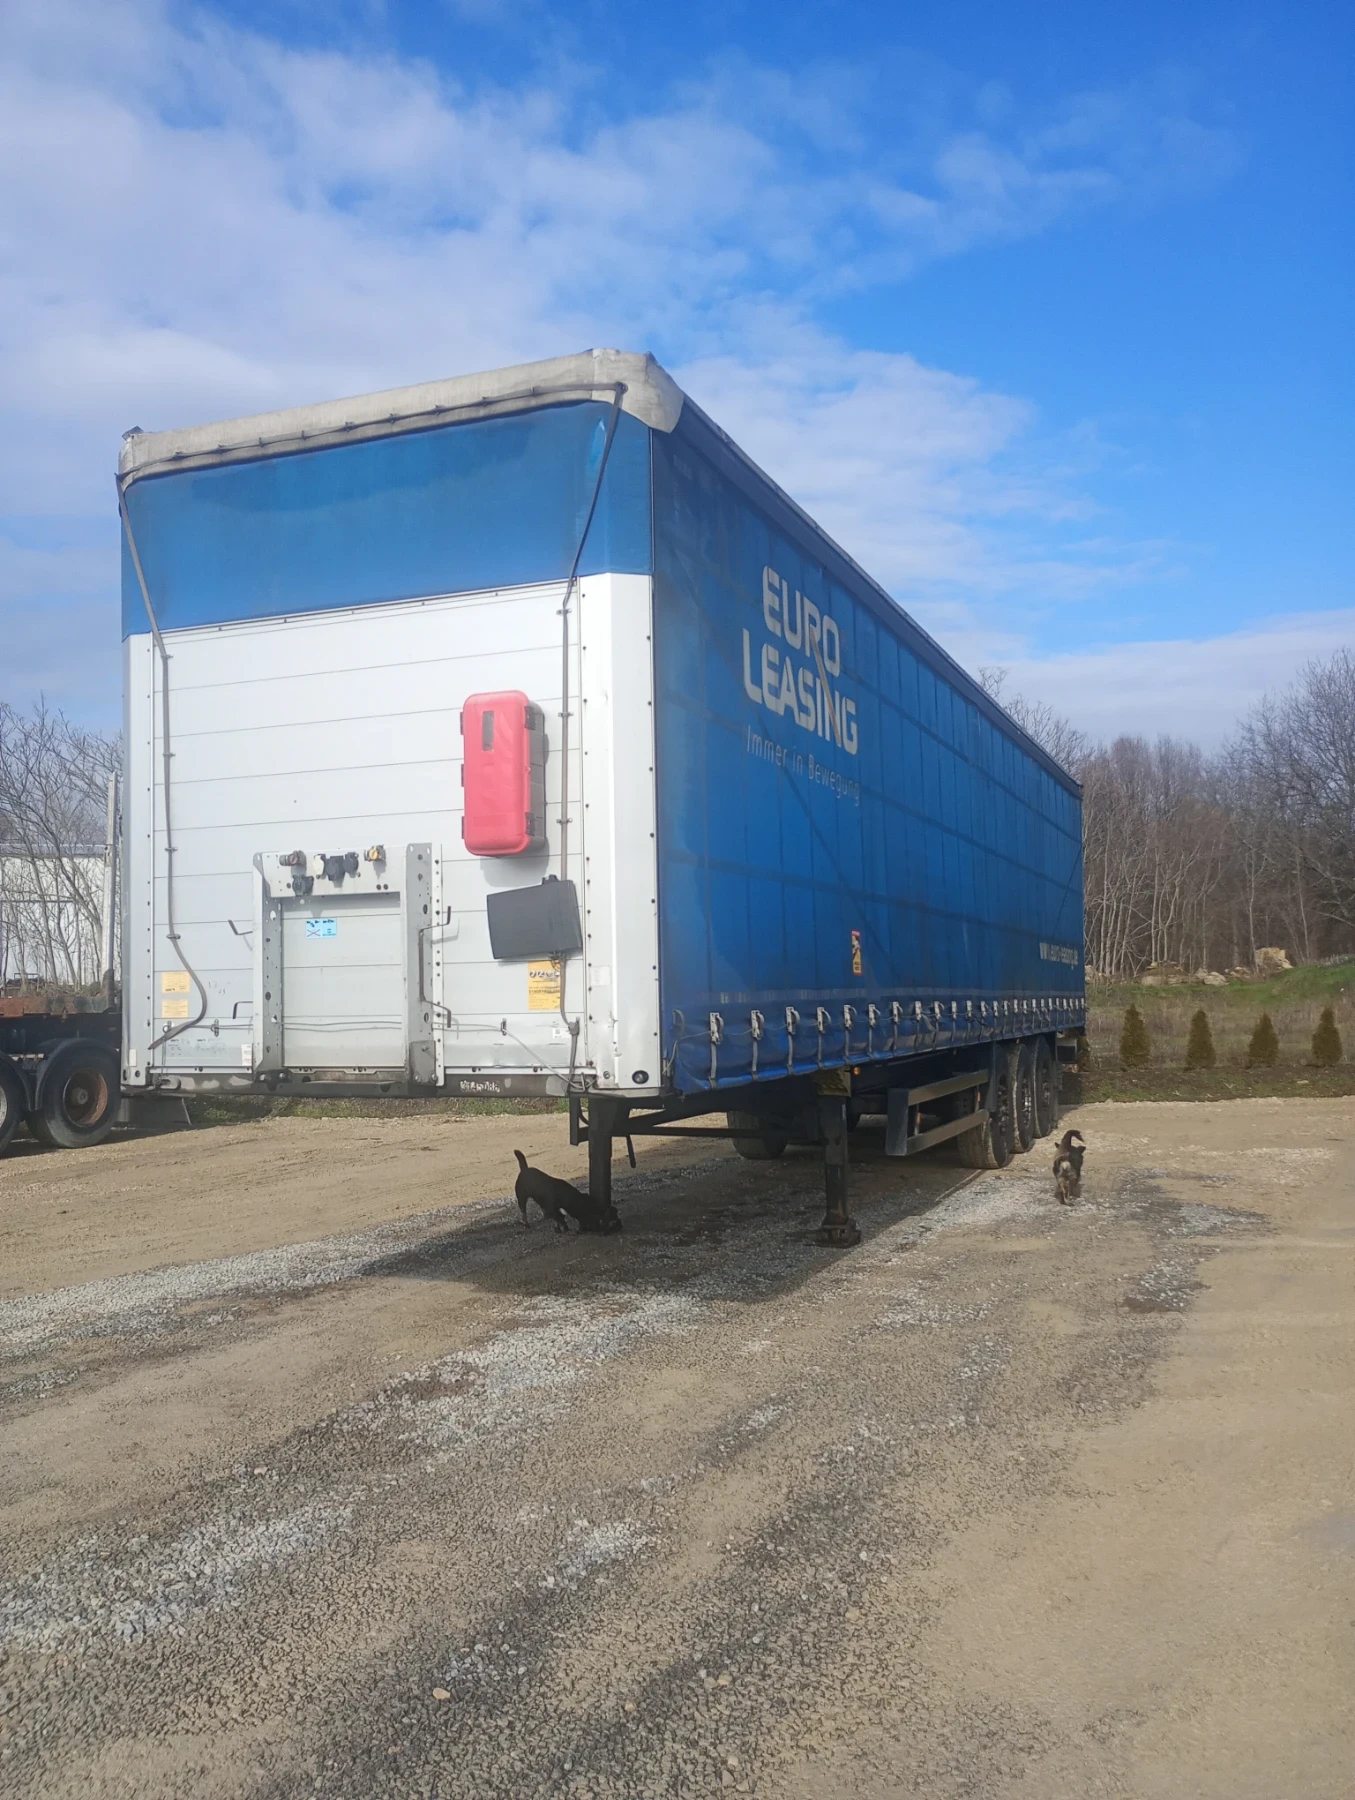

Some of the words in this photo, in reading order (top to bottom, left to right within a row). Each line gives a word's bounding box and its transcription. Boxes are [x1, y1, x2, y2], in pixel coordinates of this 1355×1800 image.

[762, 565, 840, 678] EURO
[743, 627, 858, 755] LEASING
[747, 724, 788, 767] Immer
[792, 745, 803, 776] in
[808, 753, 860, 807] Bewegung
